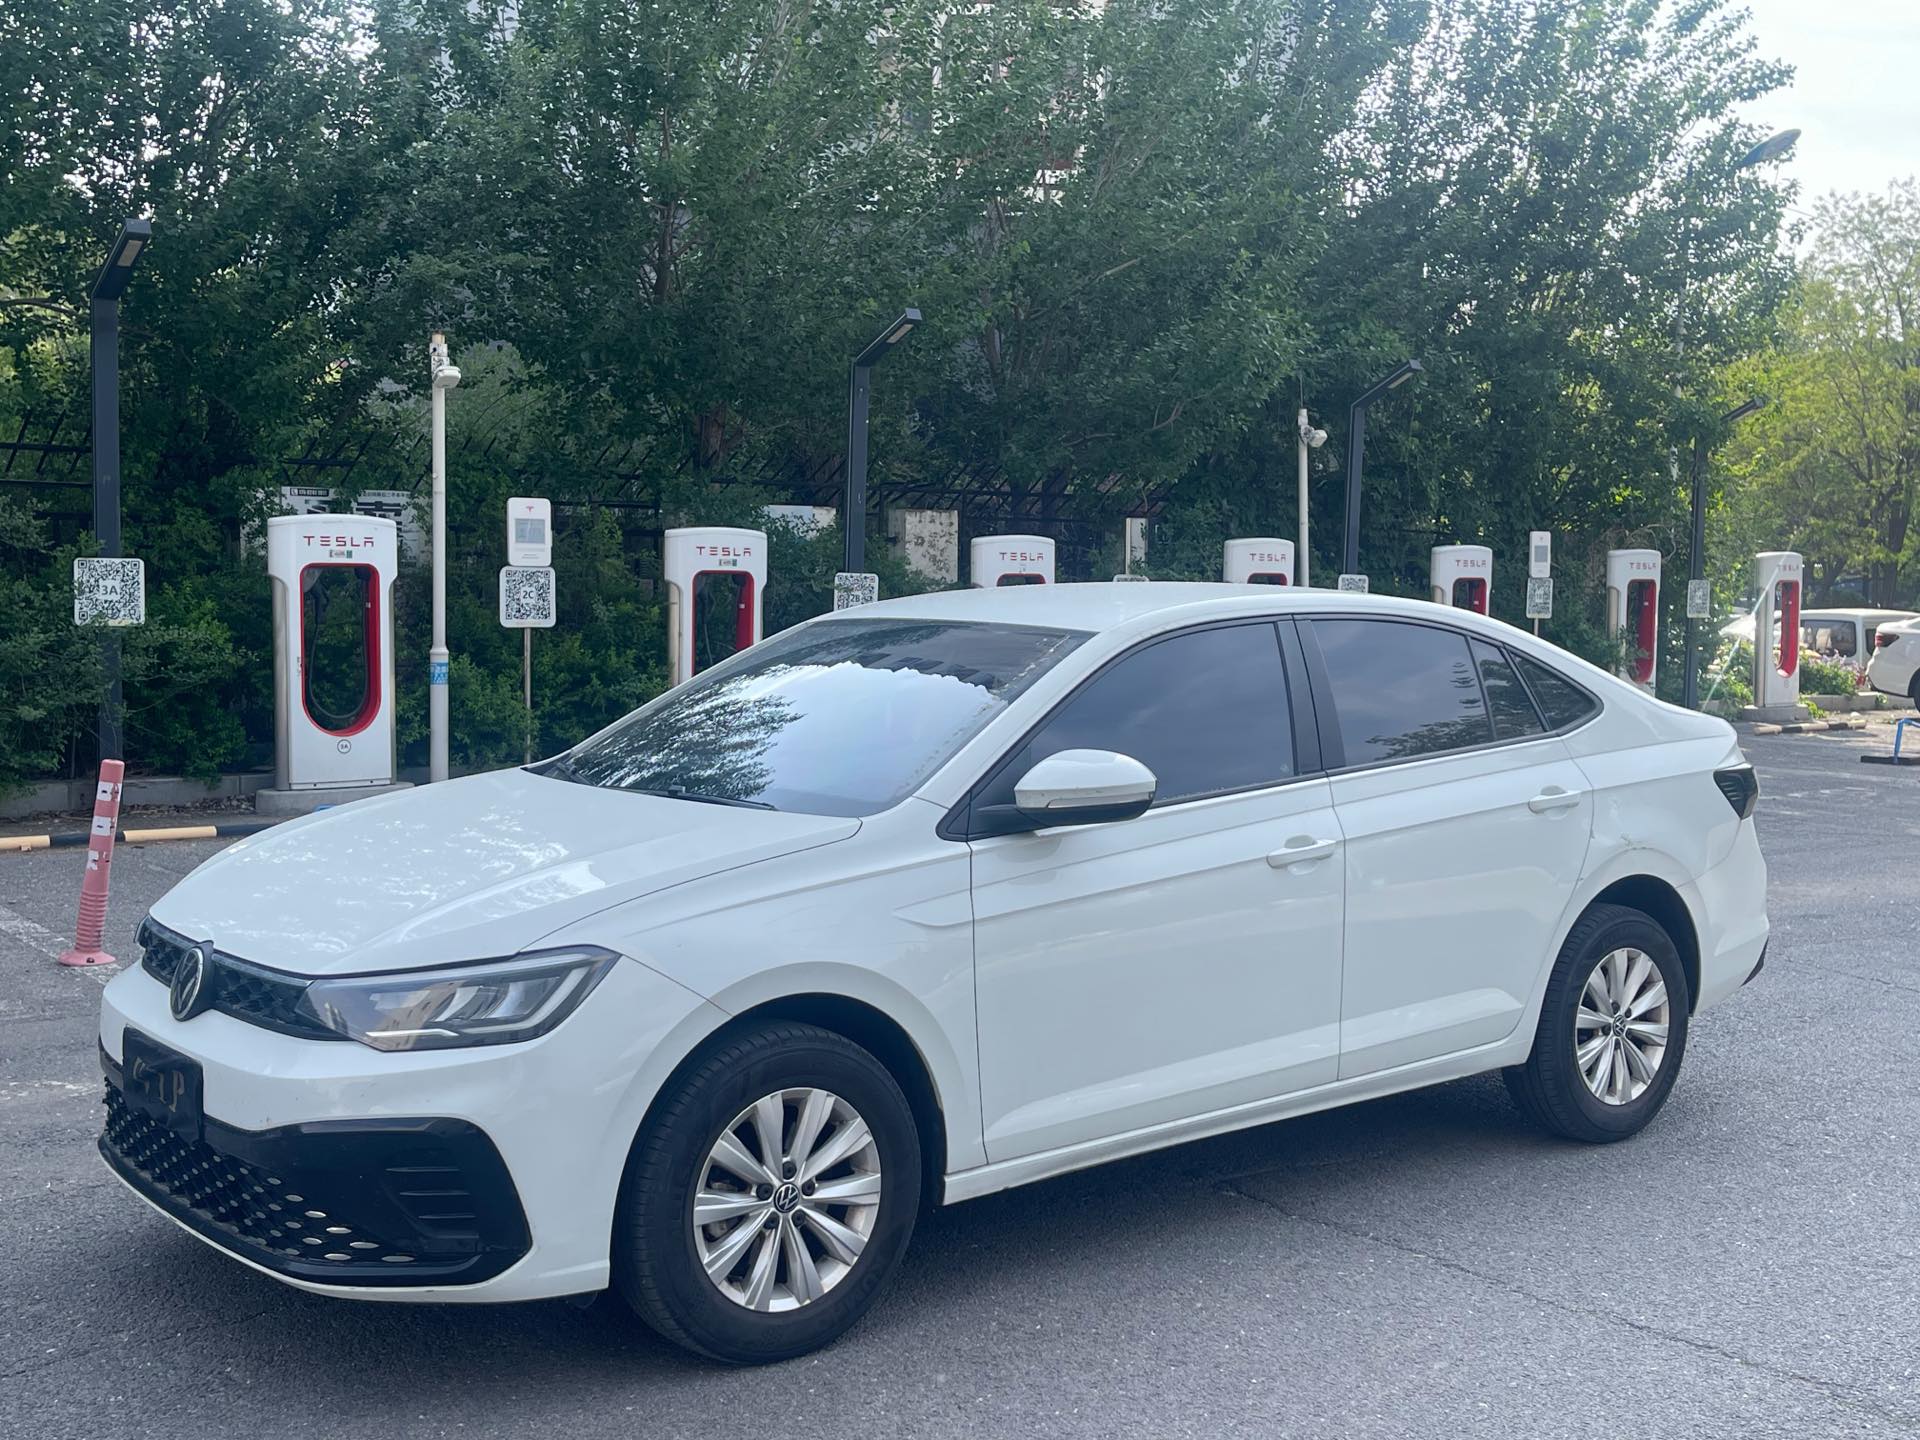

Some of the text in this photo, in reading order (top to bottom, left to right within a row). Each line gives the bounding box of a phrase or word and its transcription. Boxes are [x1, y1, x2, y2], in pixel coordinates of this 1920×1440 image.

[302, 535, 375, 547] TESLA
[696, 546, 752, 557] TESLA
[999, 551, 1044, 561] TESLA
[1249, 553, 1287, 562] TESLA
[1455, 559, 1487, 567] TESLA
[101, 585, 118, 595] 3A
[522, 590, 534, 599] 2C
